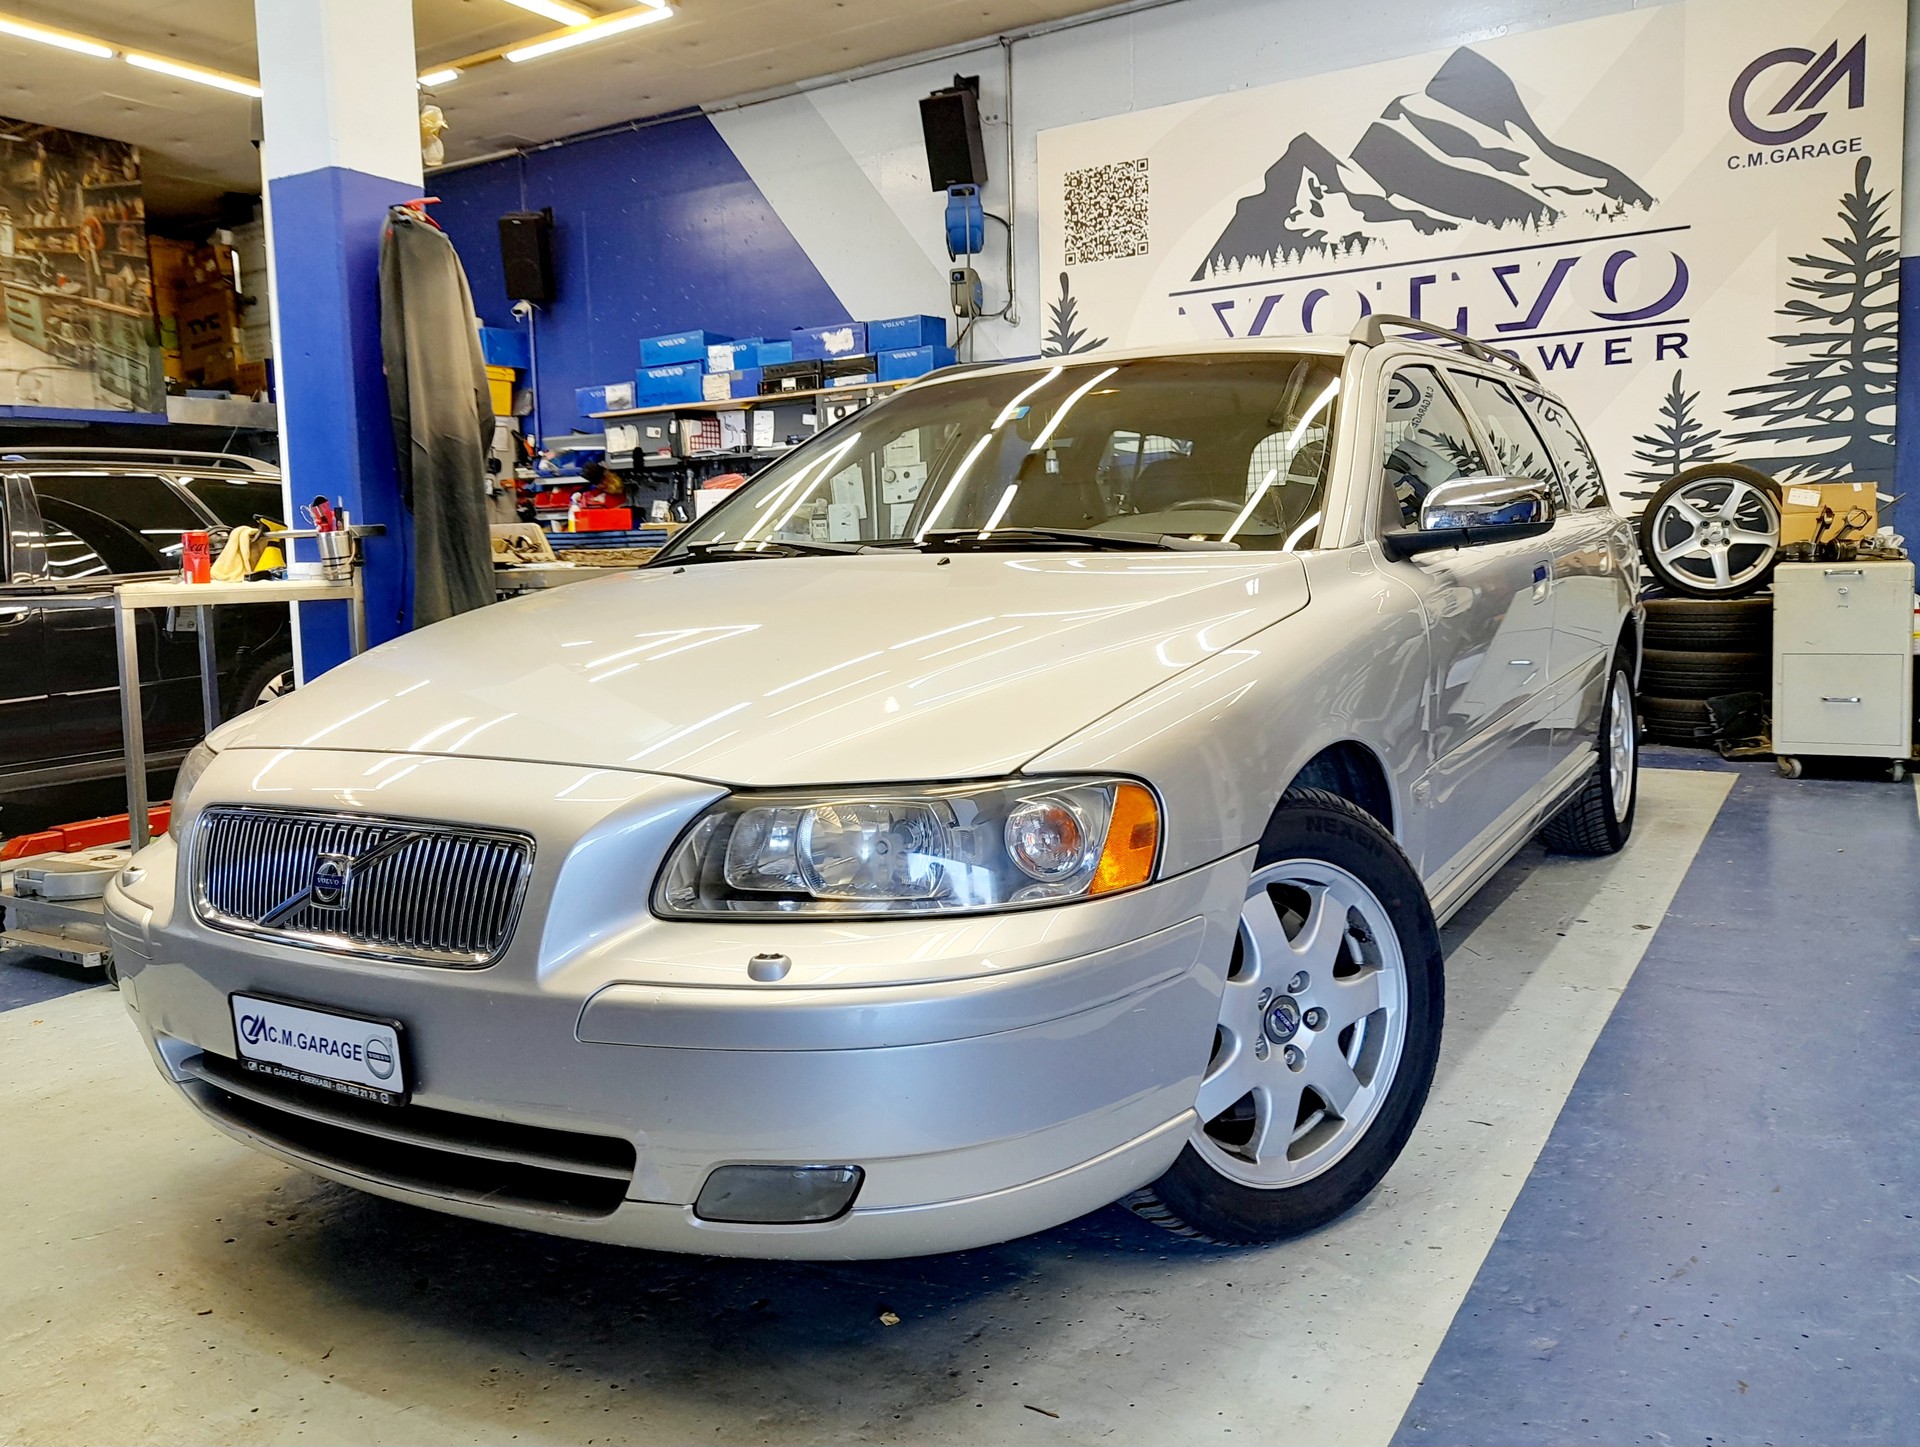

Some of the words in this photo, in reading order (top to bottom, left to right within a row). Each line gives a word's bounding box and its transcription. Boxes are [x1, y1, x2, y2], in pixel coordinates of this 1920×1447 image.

[1727, 136, 1863, 170] C.M.GARAGE
[1178, 249, 1690, 342] VOLVO
[882, 320, 906, 329] VOLVO
[657, 337, 687, 348] VOLVO
[1455, 331, 1690, 371] OWER
[647, 367, 685, 379] VOLVO
[1305, 815, 1383, 859] NEXEN
[316, 877, 340, 886] VOLVO
[268, 1026, 363, 1062] C.M.GARAGE
[273, 1067, 300, 1081] GARAGE
